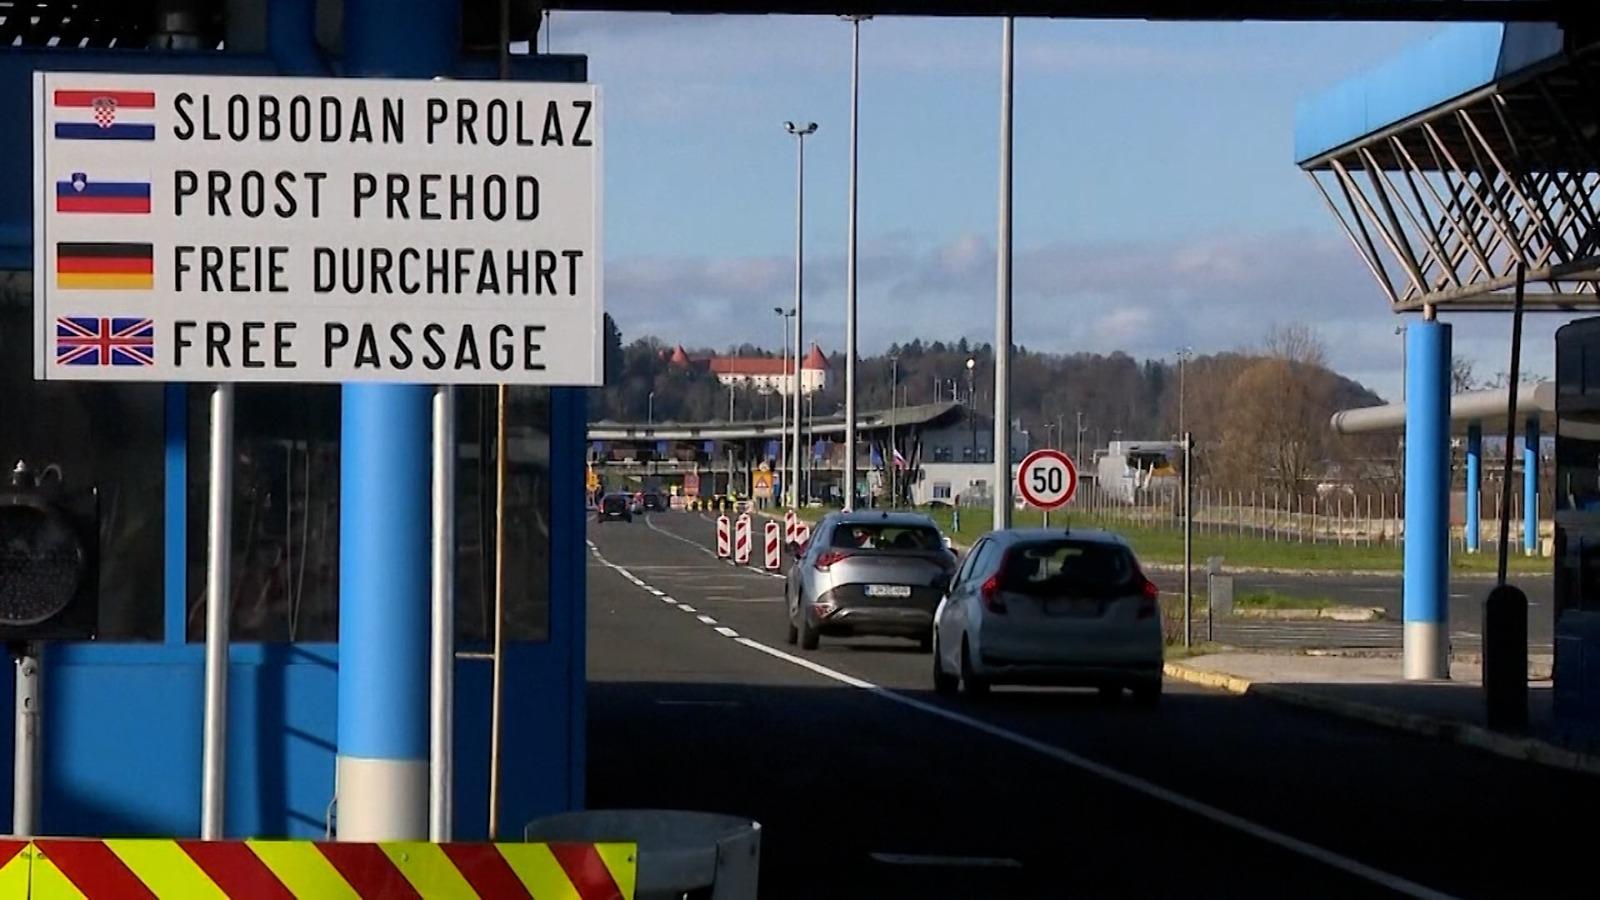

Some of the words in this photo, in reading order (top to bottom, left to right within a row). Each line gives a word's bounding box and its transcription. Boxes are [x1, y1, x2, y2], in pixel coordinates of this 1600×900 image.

[174, 93, 404, 144] SLOBODAN
[427, 98, 593, 147] PROLAZ
[174, 170, 328, 219] PROST
[353, 173, 540, 222] PREHOD
[174, 245, 289, 293] FREIE
[314, 247, 584, 296] DURCHFAHRT
[173, 320, 297, 369] FREE
[324, 322, 547, 371] PASSAGE
[1033, 467, 1062, 493] 50
